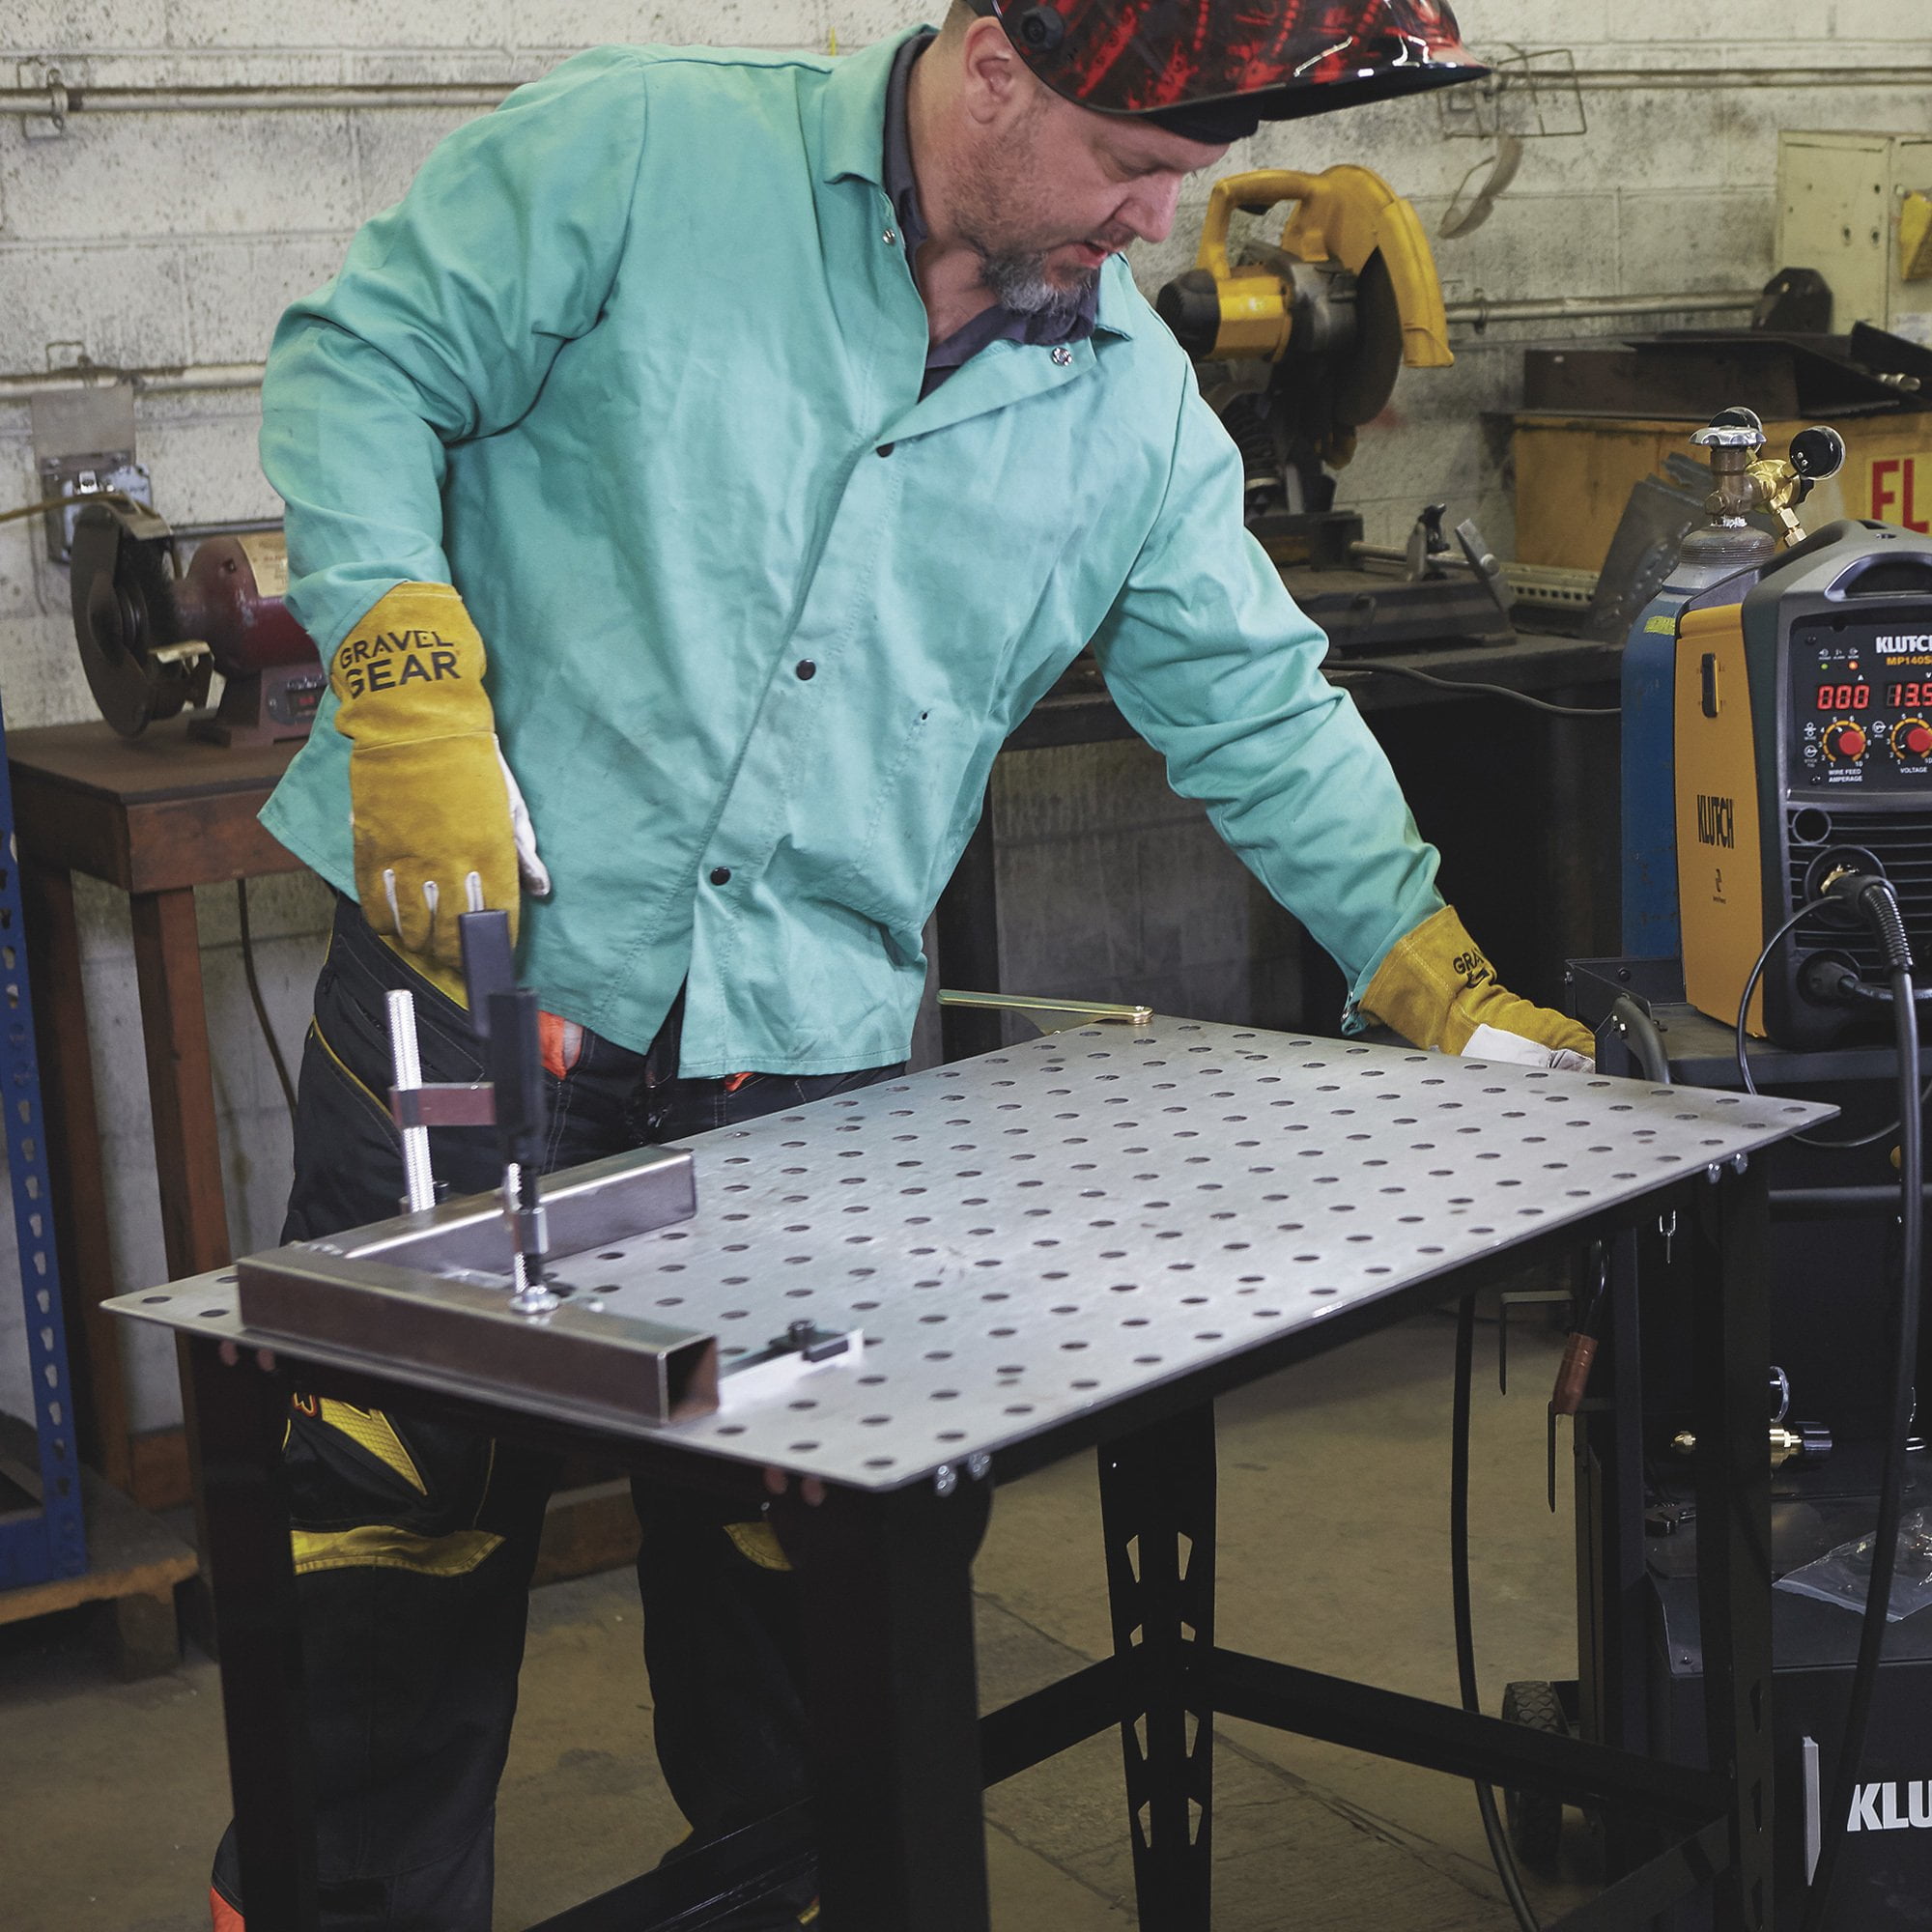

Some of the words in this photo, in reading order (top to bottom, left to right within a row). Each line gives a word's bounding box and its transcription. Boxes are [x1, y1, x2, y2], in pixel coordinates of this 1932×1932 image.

[1871, 457, 1929, 534] FL
[339, 630, 454, 669] GRAVEL
[1876, 634, 1932, 653] KLUTC
[346, 651, 461, 700] GEAR
[1817, 684, 1871, 710] 000
[1696, 794, 1734, 849] KLUTCH
[1846, 1779, 1932, 1832] KLU
